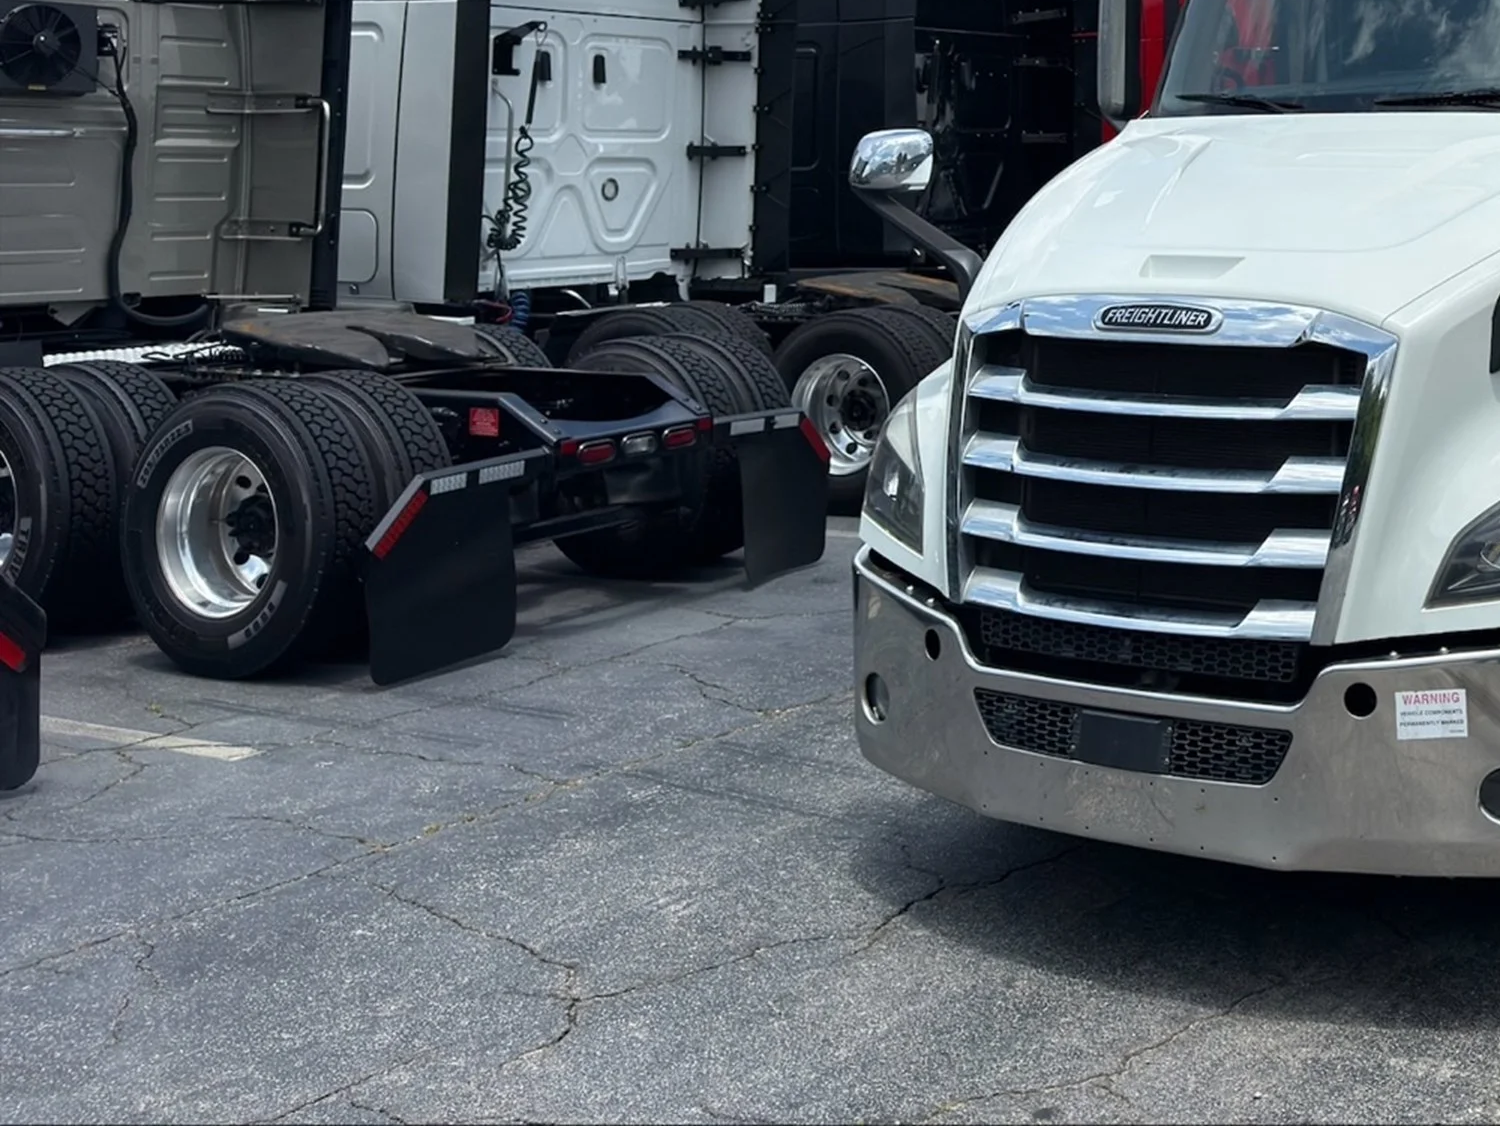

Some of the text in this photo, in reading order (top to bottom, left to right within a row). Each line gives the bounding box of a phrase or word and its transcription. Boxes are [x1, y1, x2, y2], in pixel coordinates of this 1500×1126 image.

[1104, 307, 1209, 326] FREIGHTLINER
[1401, 691, 1461, 706] WARNING
[1400, 720, 1440, 728] PERMANENTLY
